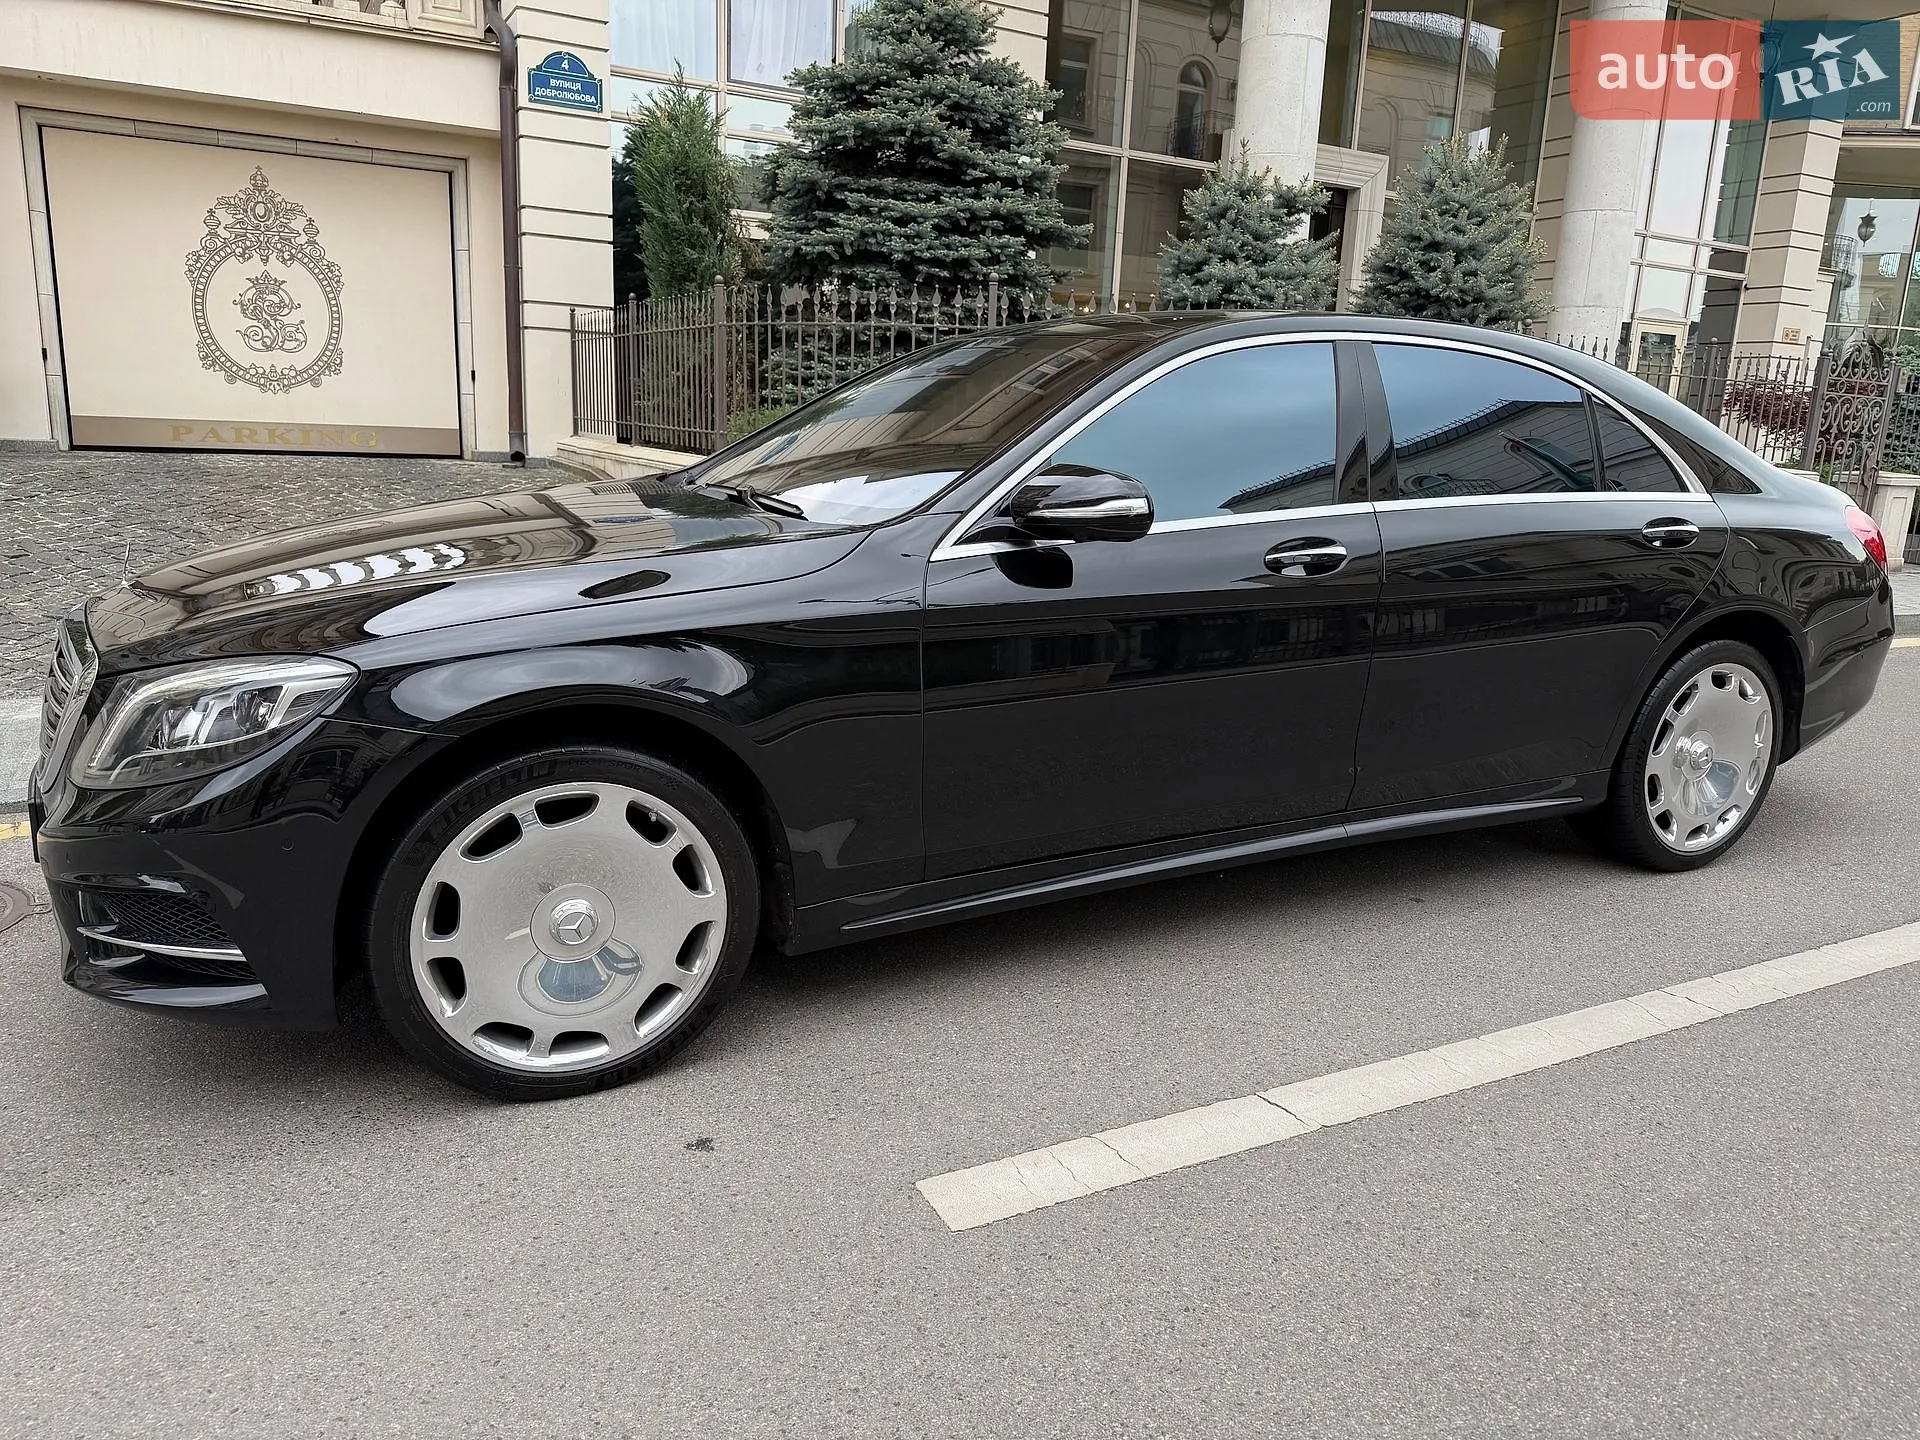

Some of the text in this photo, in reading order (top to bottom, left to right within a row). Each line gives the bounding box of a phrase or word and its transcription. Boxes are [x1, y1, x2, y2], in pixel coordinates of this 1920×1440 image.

[561, 59, 569, 72] 4
[549, 78, 582, 91] ВУЛИЦЯ
[534, 87, 597, 103] ДОБРОЛЮБОВА
[167, 424, 378, 448] PARKING
